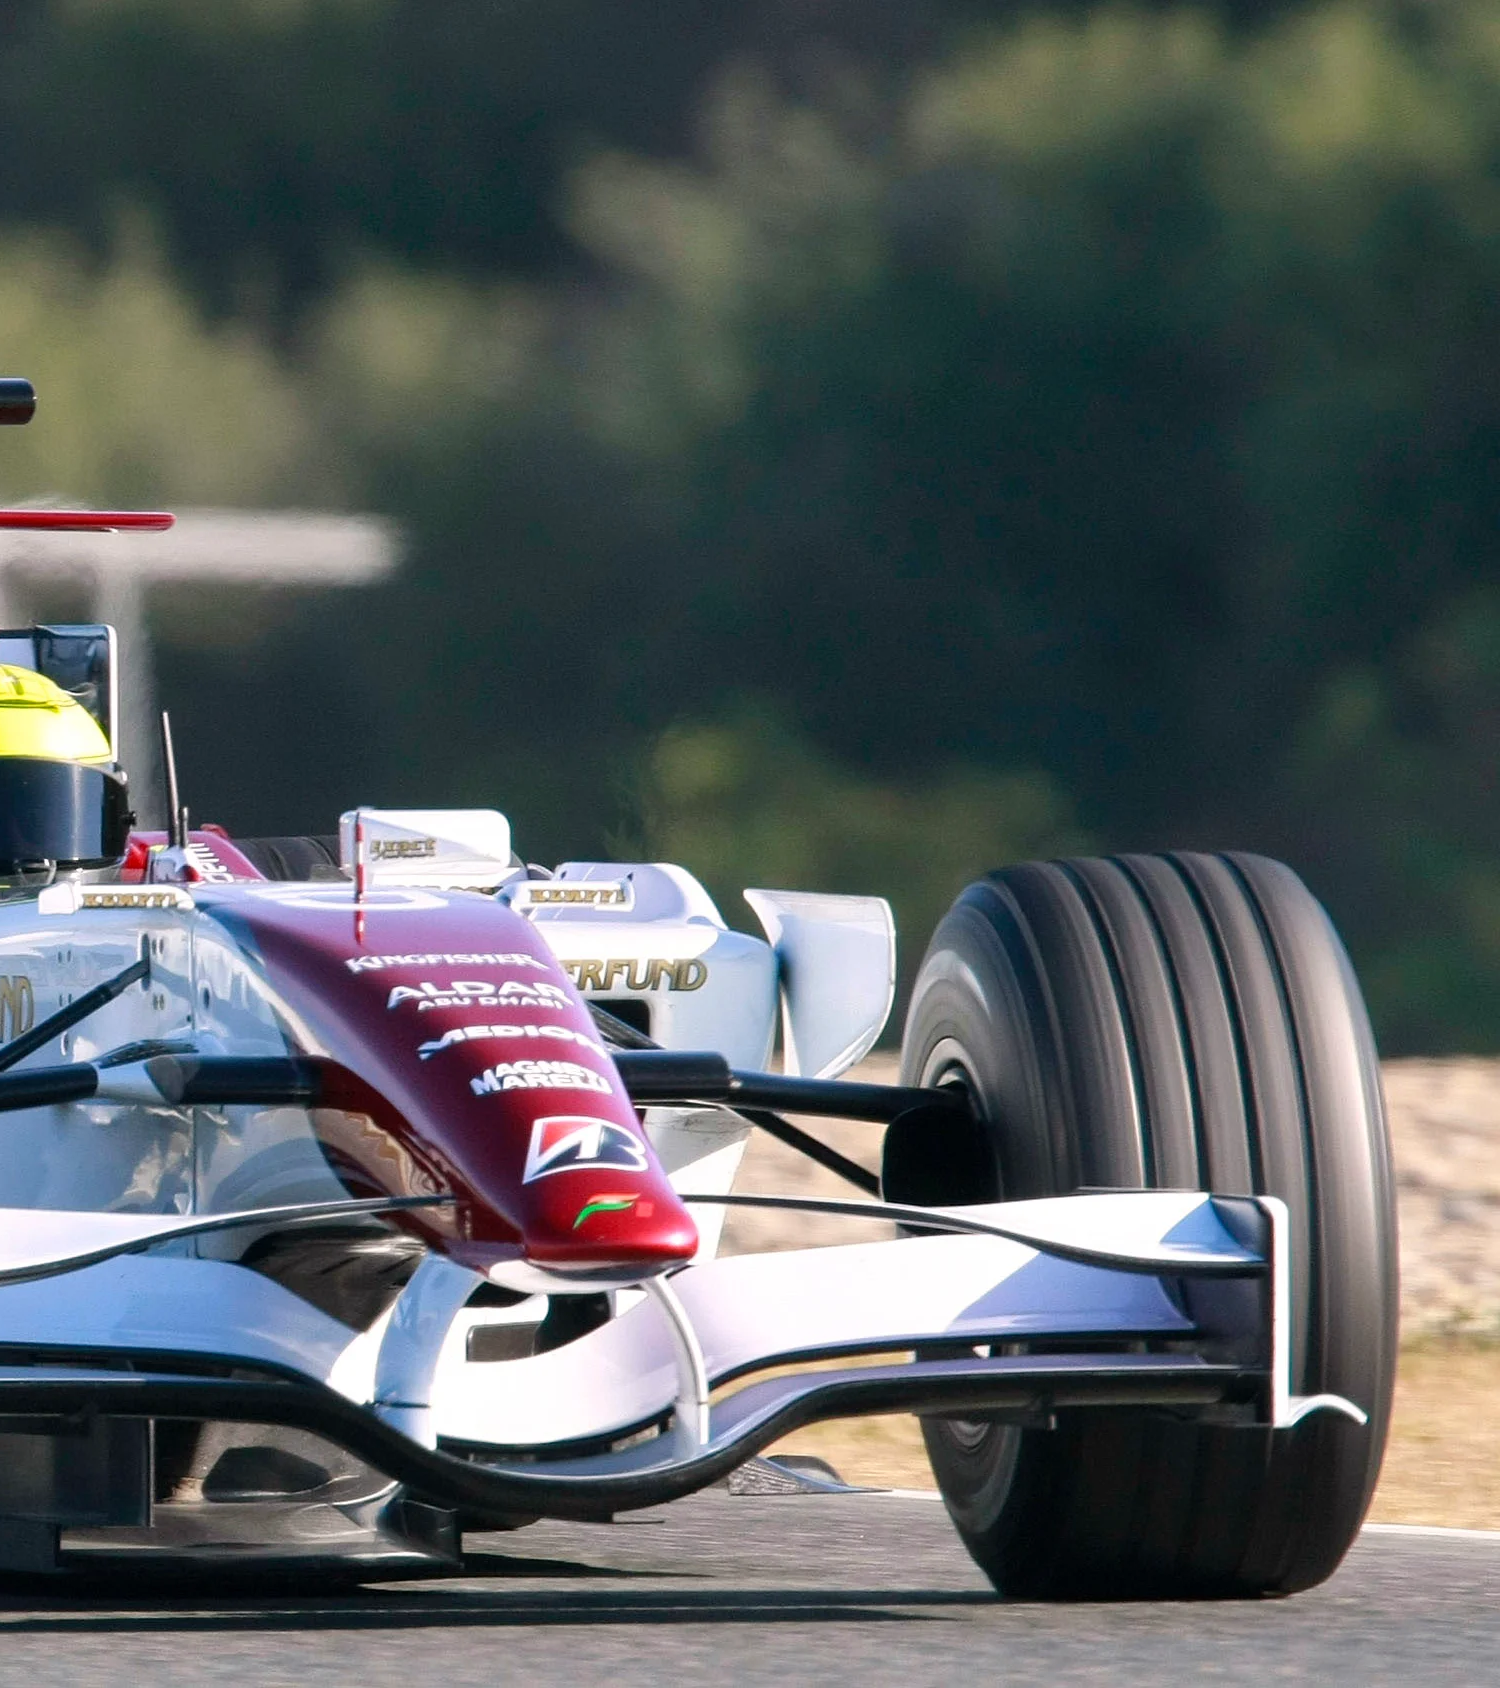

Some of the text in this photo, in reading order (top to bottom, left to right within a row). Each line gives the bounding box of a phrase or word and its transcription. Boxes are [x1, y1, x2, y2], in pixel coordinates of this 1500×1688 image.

[345, 953, 551, 975] KINGFISHER
[386, 980, 575, 1010] ALDAR
[417, 995, 564, 1011] ABU DHABI
[417, 1024, 609, 1060] MEDION
